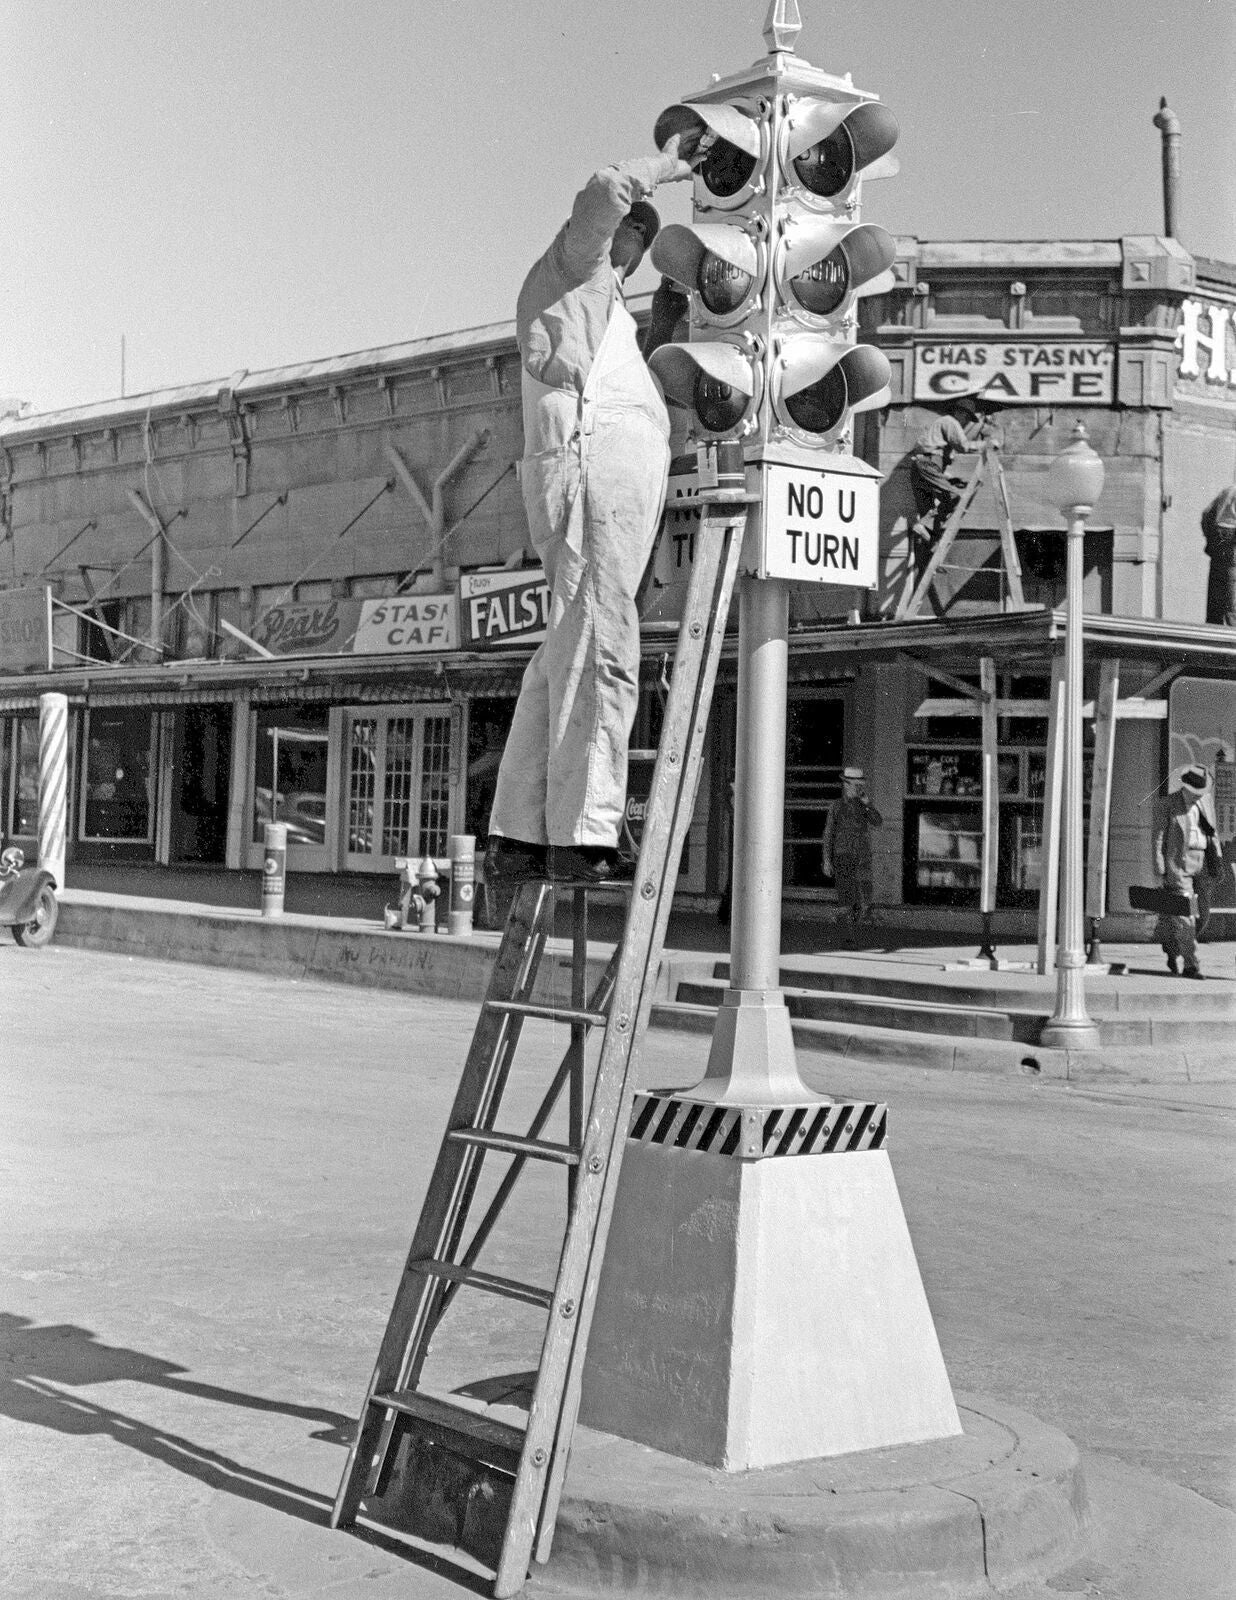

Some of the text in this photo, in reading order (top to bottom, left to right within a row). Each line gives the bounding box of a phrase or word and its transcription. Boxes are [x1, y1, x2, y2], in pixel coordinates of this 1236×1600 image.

[921, 347, 987, 365] CHAS
[1174, 299, 1236, 384] H
[929, 370, 1103, 397] CAFE
[788, 482, 855, 523] NO U
[786, 529, 859, 570] TURN
[470, 585, 551, 640] FALST
[388, 627, 449, 645] CAF
[626, 797, 649, 821] Coca
